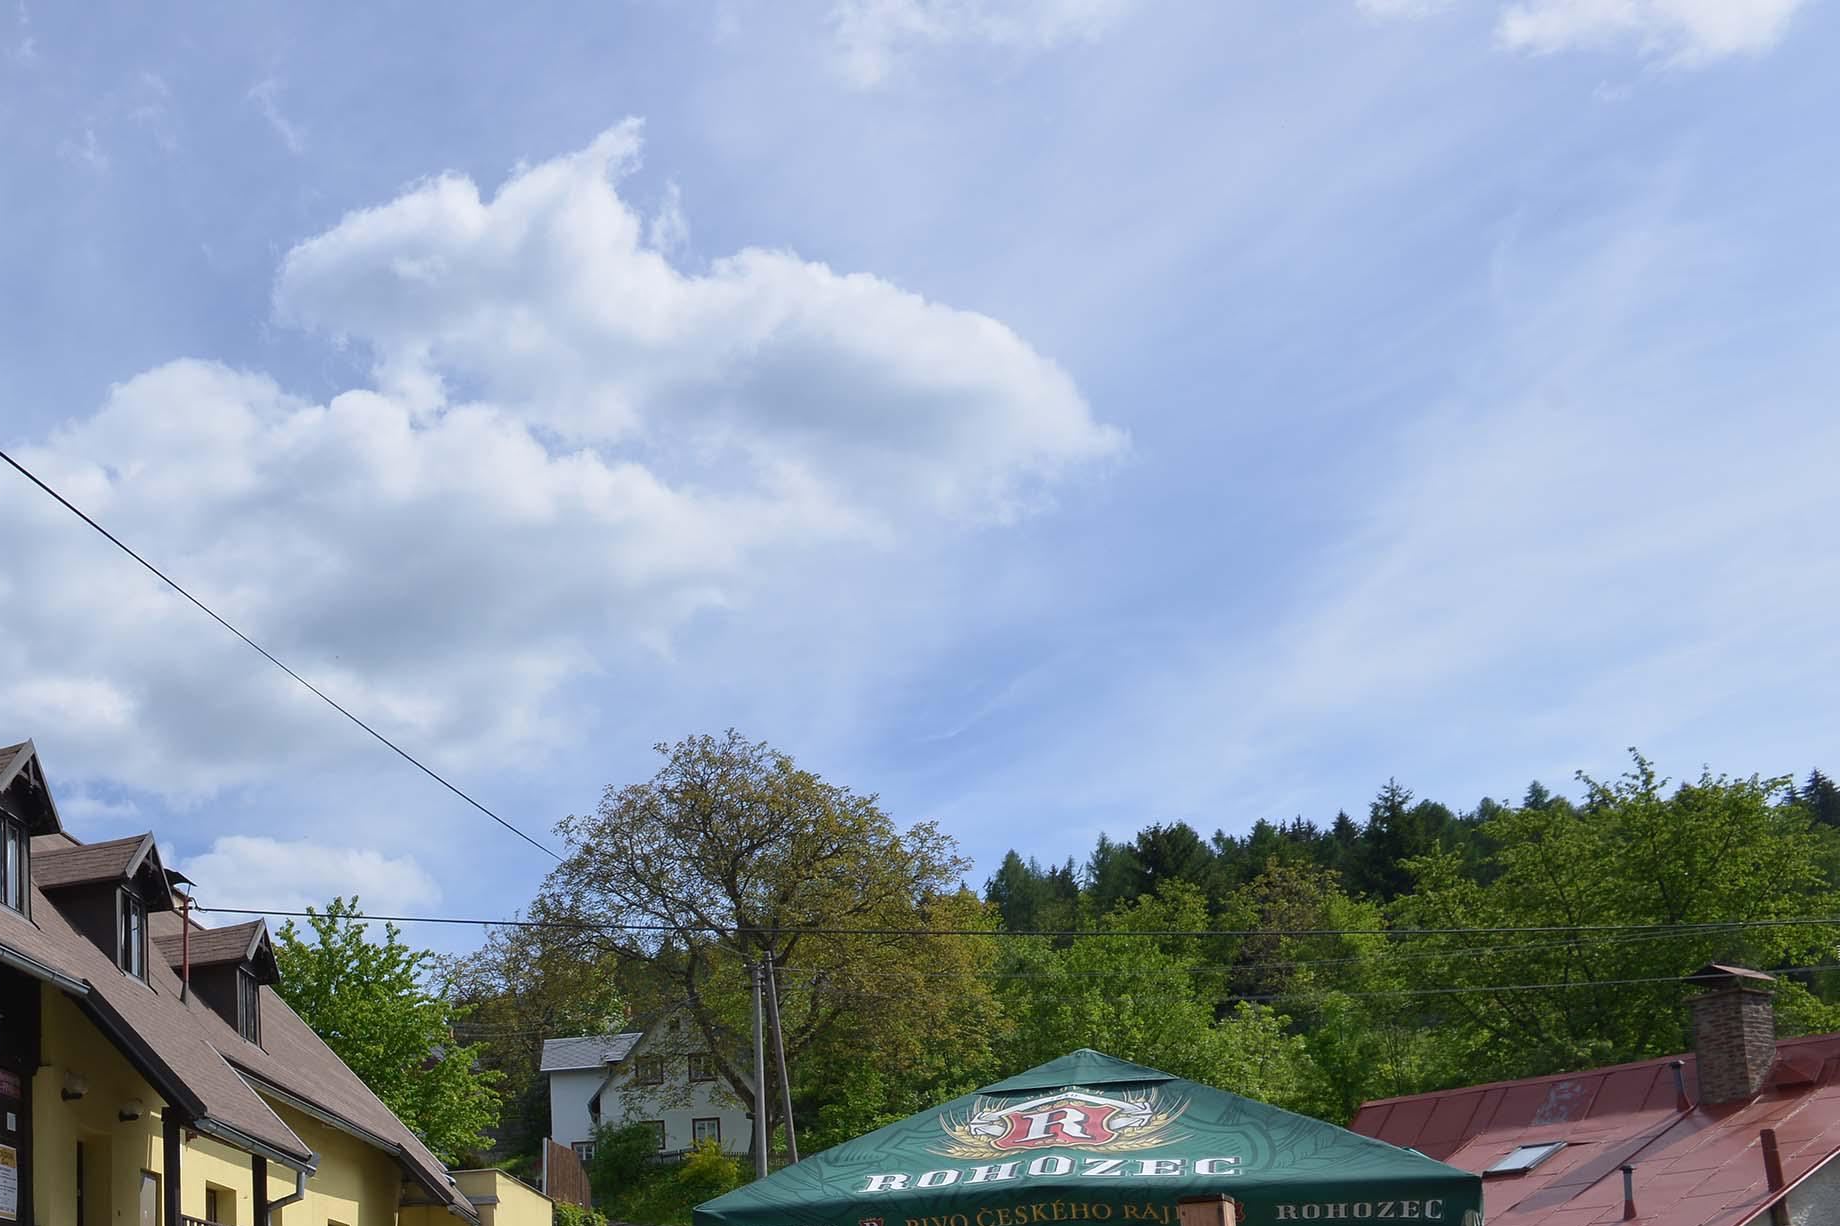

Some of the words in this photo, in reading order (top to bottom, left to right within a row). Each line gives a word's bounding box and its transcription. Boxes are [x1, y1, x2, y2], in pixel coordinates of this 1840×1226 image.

[1013, 1108, 1093, 1143] R
[857, 1156, 1242, 1193] ROHOZEC
[1276, 1199, 1443, 1220] ROHOZEC
